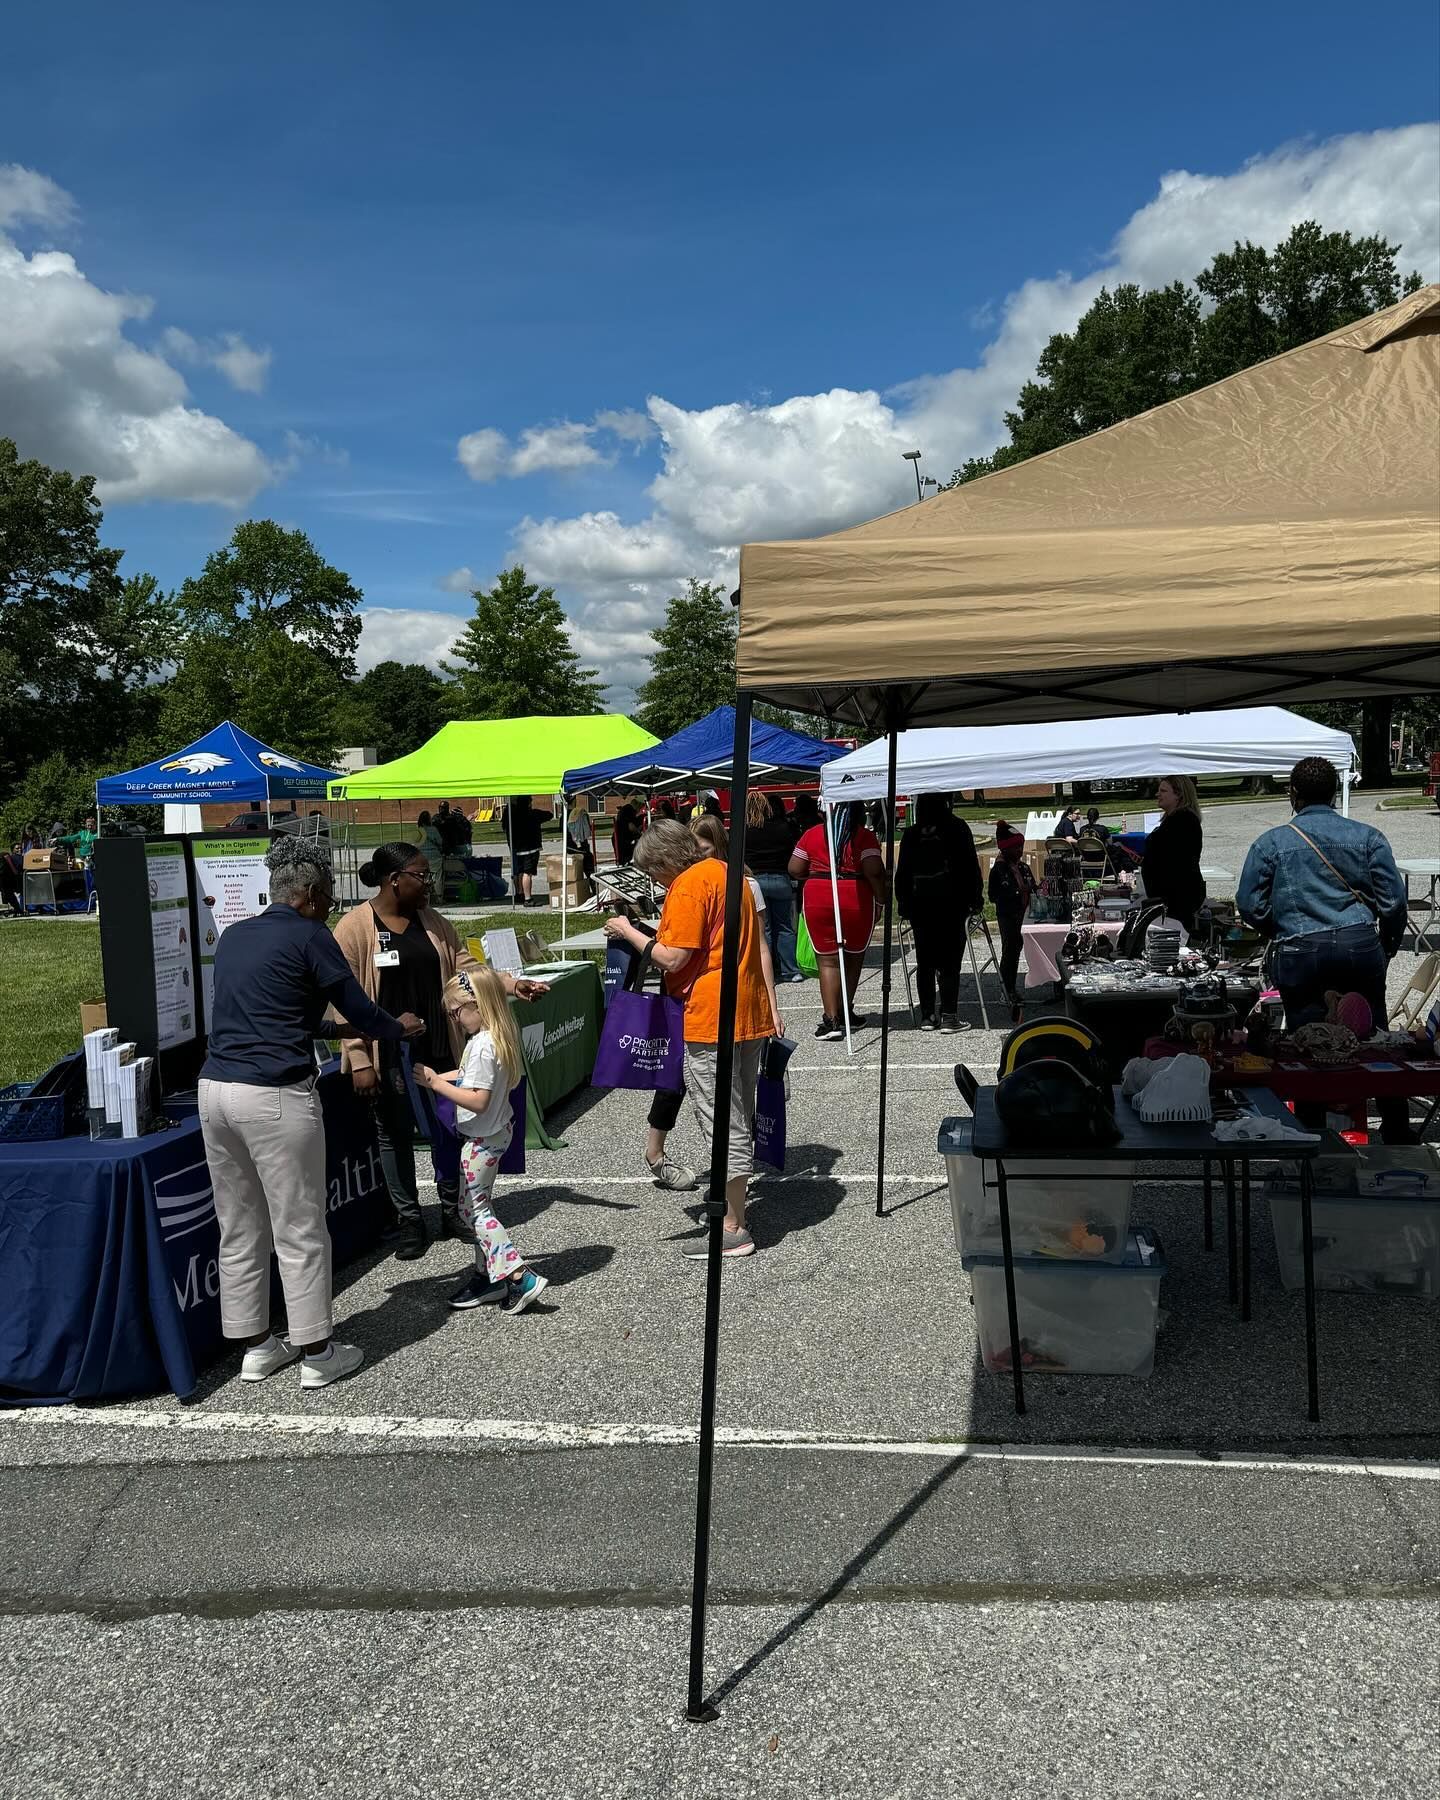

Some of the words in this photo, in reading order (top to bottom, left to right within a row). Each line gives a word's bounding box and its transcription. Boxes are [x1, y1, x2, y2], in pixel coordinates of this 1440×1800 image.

[126, 782, 146, 791] DEEP
[148, 782, 173, 790] CREEK
[174, 781, 206, 789] MAGNET
[208, 780, 237, 788] MIDDLE
